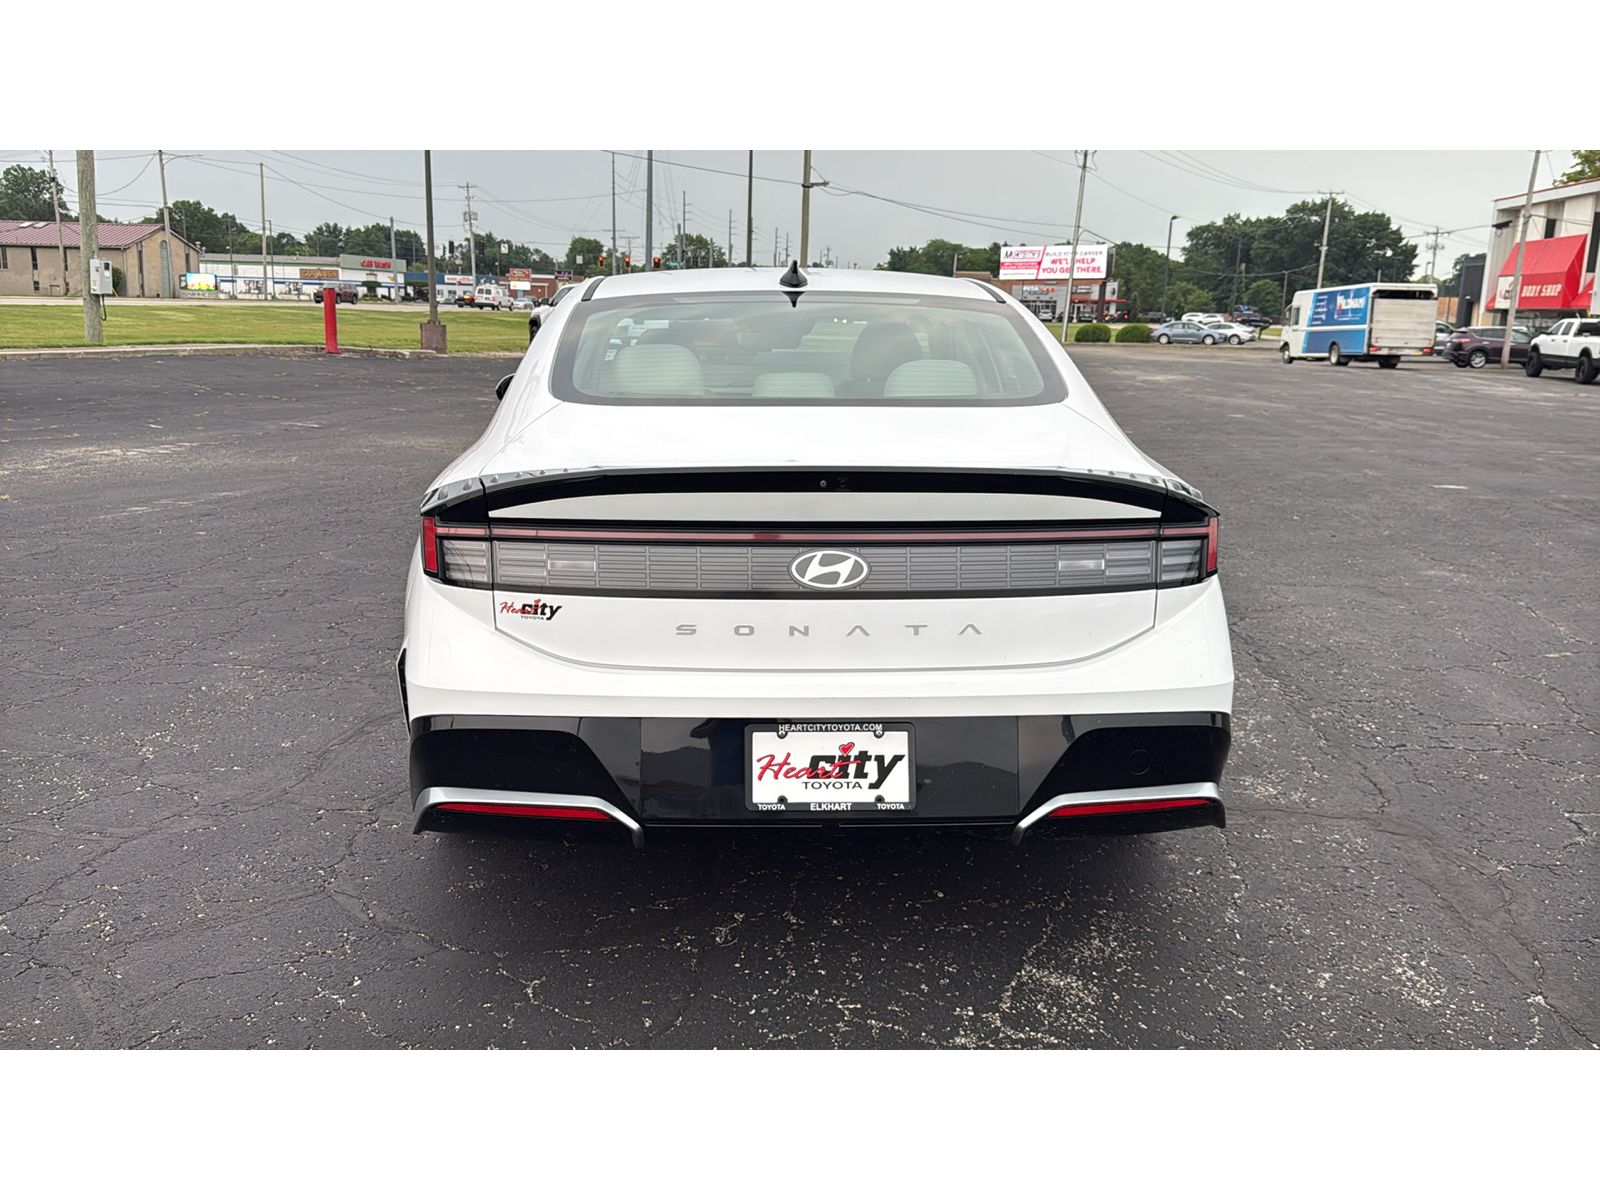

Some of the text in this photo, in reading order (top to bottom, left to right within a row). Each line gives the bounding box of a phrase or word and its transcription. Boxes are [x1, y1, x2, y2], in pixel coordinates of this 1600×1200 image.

[1050, 257, 1096, 266] WE'L HELP
[1042, 266, 1058, 274] YOU
[1059, 266, 1073, 274] GE
[1521, 284, 1541, 298] BODY
[1541, 283, 1562, 297] SHOP
[675, 623, 983, 637] SONATA
[778, 723, 883, 732] HEARTCITYTOYOTA.COM
[756, 742, 906, 790] Heart city
[801, 781, 863, 790] TOYOTA
[757, 803, 786, 811] TOYOTA
[810, 802, 852, 811] ELKHART
